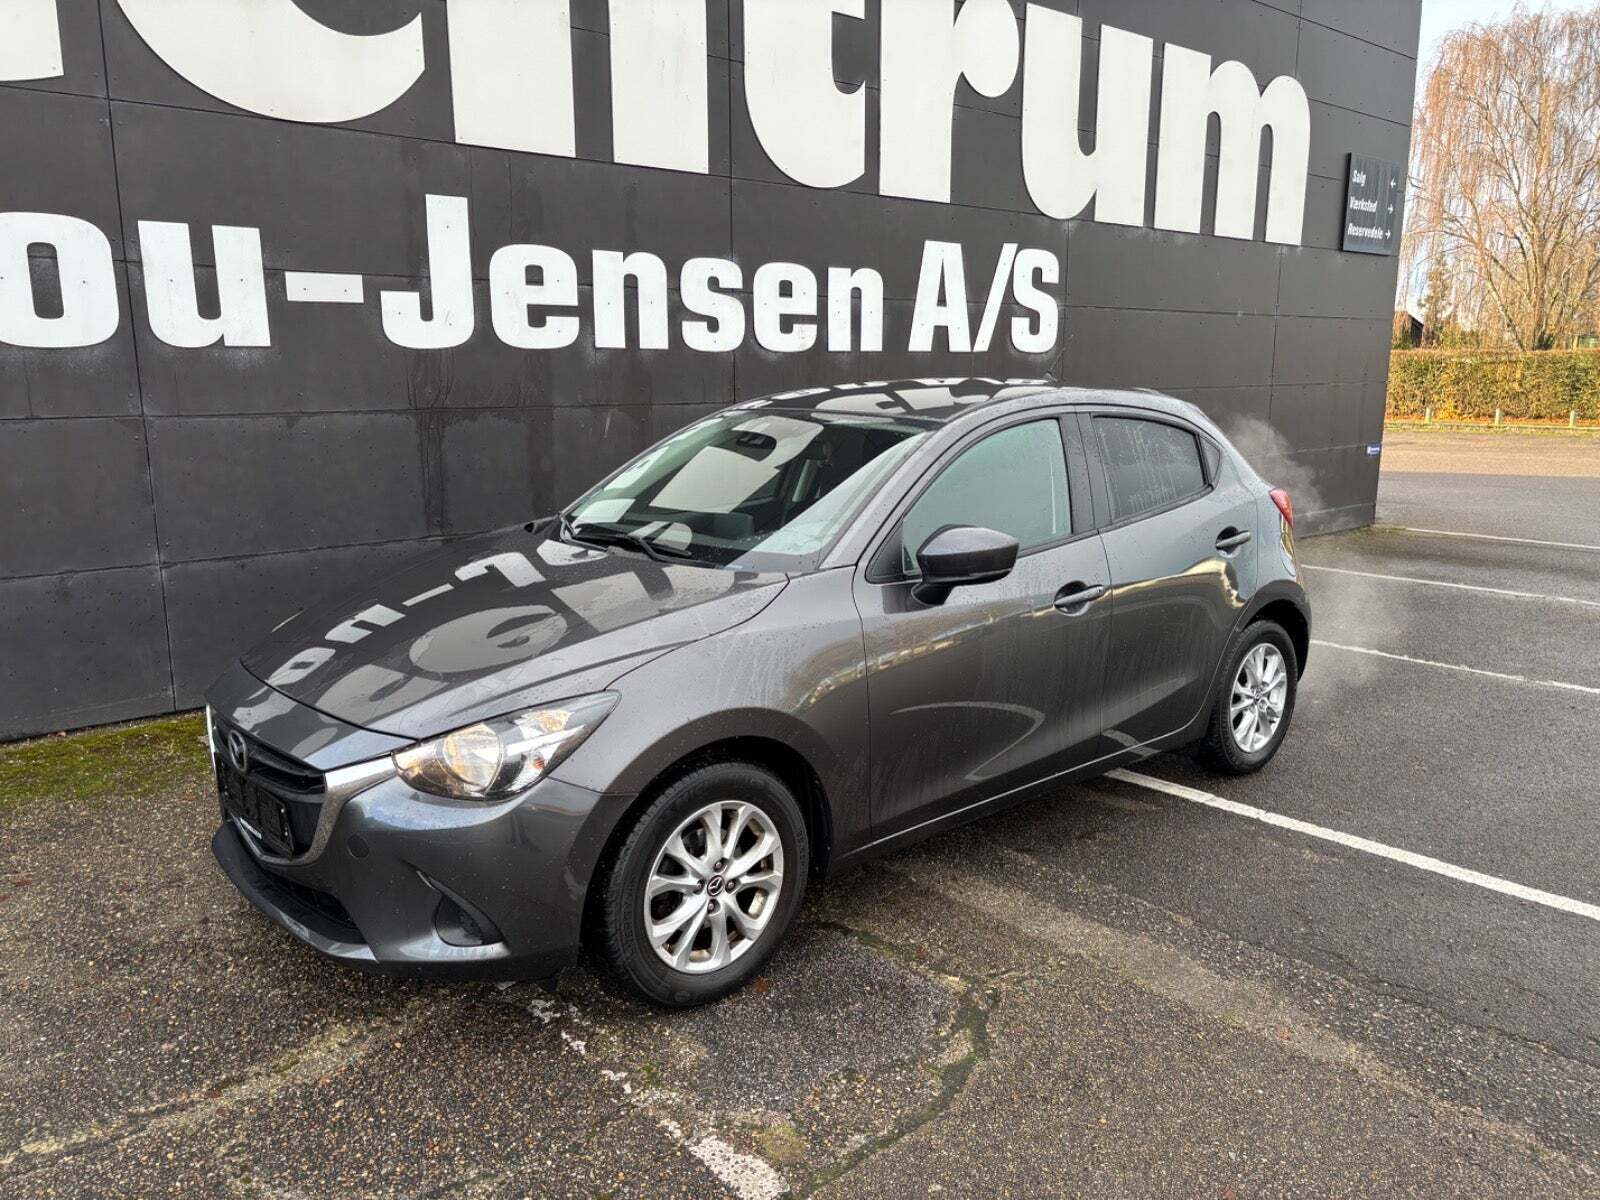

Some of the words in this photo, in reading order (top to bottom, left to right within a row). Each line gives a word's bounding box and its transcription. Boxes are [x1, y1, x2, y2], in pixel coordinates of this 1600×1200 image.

[1351, 169, 1367, 187] Salg
[1347, 222, 1383, 240] Reservedele
[908, 240, 1060, 354] A/S
